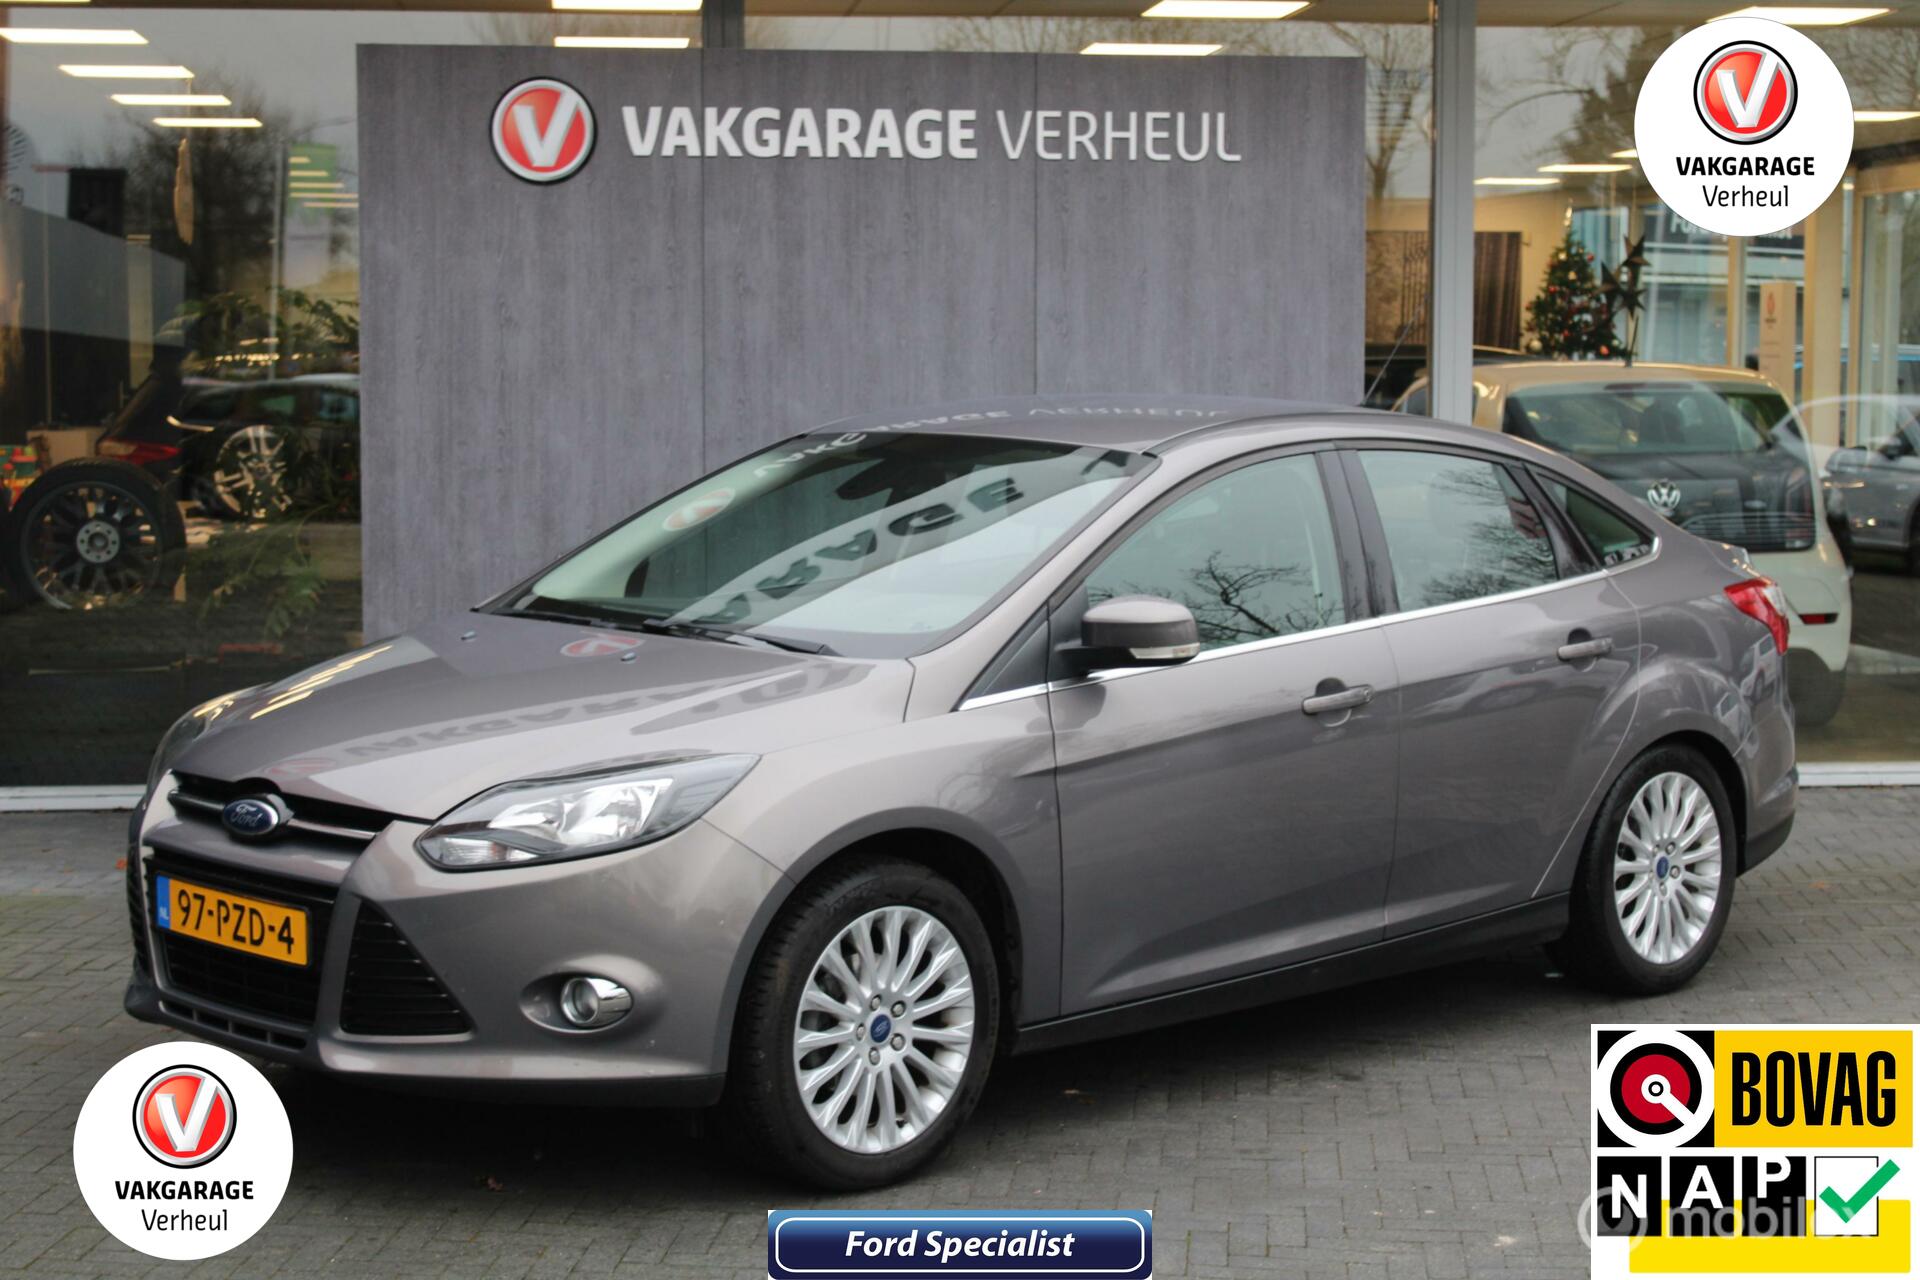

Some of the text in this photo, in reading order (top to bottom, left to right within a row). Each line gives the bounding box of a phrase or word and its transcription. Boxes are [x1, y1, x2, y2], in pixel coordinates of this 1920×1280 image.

[512, 88, 1242, 167] V VAKGARAGE VERHEUL
[178, 889, 295, 955] 97-PZD-4
